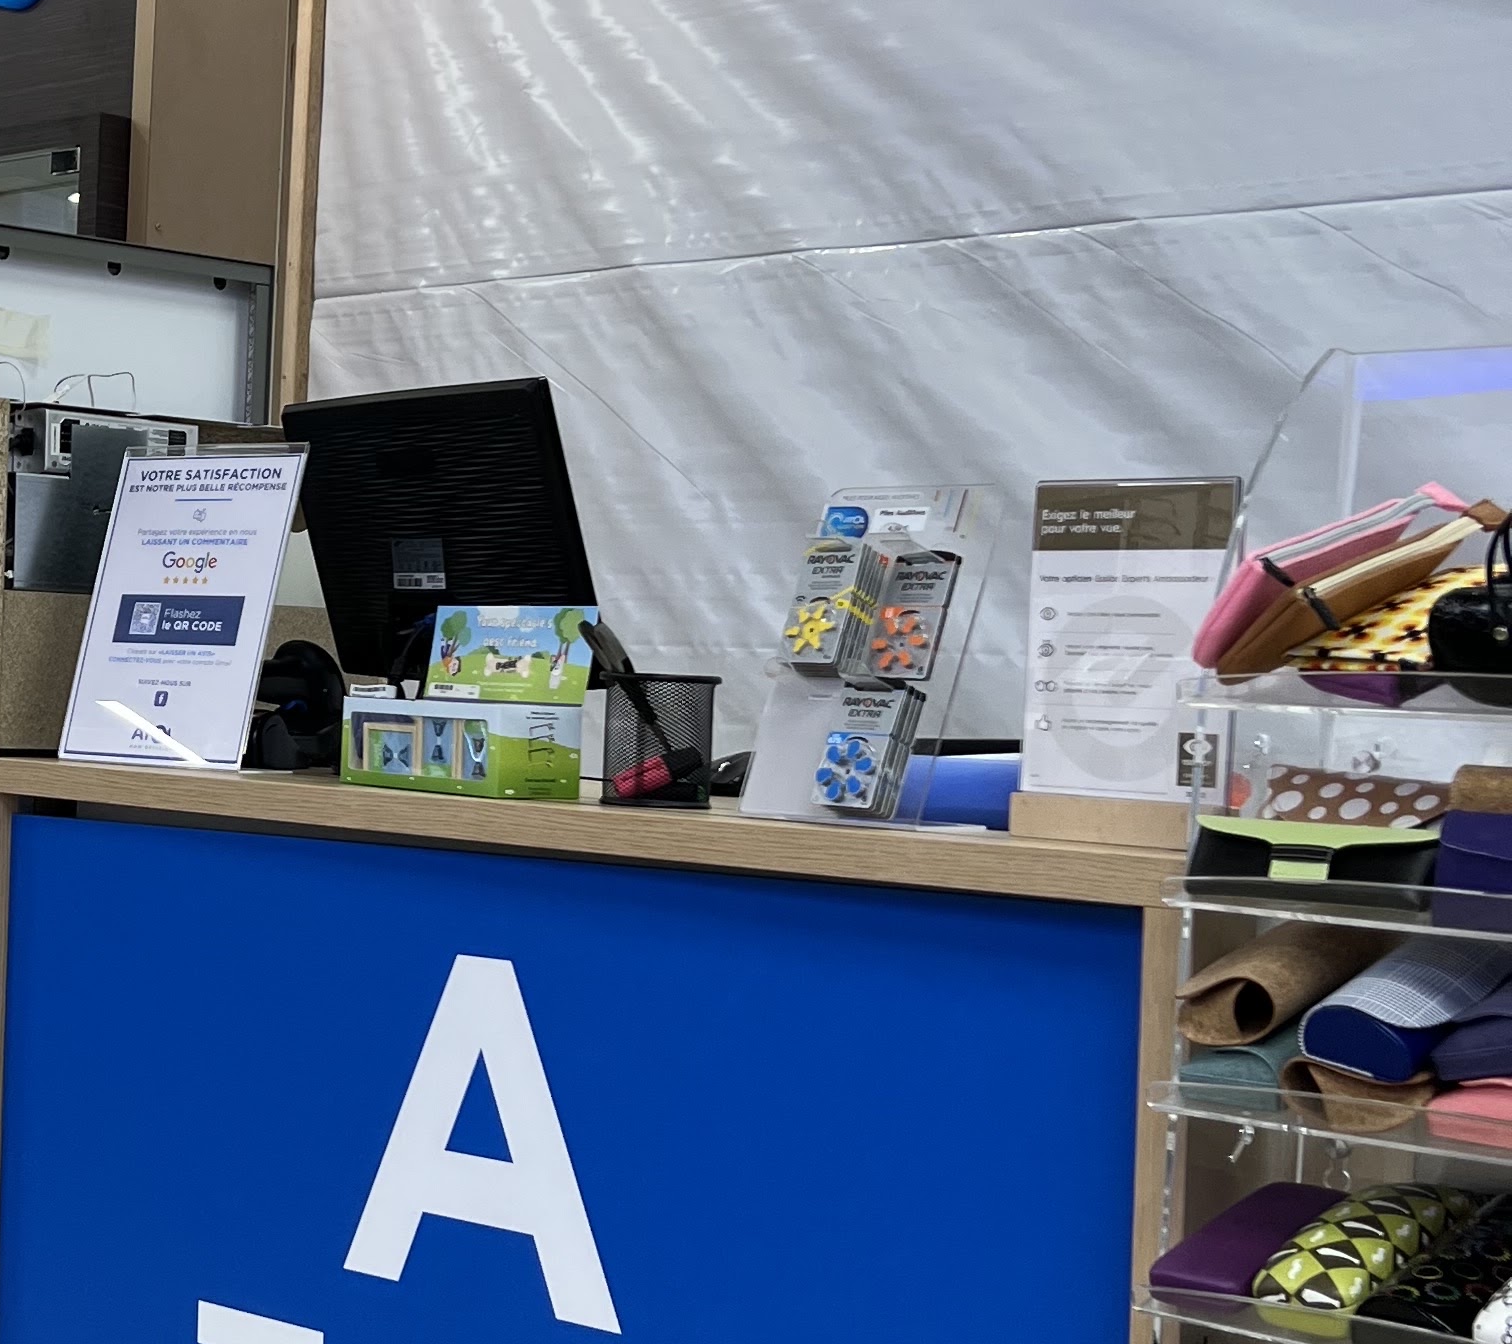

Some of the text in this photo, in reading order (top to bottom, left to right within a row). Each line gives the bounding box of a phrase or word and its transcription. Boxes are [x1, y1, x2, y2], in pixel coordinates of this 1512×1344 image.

[141, 468, 283, 482] VOTRE SATISFACTION
[129, 482, 287, 493] EST NOTRE PLUS BELLE RÉCOMPENSE
[1041, 509, 1076, 523] Exigez
[1079, 509, 1090, 520] le
[137, 528, 168, 537] Partagez
[188, 528, 228, 537] expérience
[1041, 525, 1066, 536] pour
[1069, 523, 1097, 534] votre
[141, 538, 248, 546] LAISSANT UN COMMENTAIRE
[162, 551, 218, 573] Google
[807, 554, 855, 565] RAYOVAC
[812, 566, 845, 575] EXTRA
[895, 571, 947, 581] RAYOVAC
[164, 608, 202, 619] Flashez
[161, 620, 223, 632] le QR CODE
[842, 697, 895, 709] RAYOVAC
[848, 709, 882, 718] EXTRA
